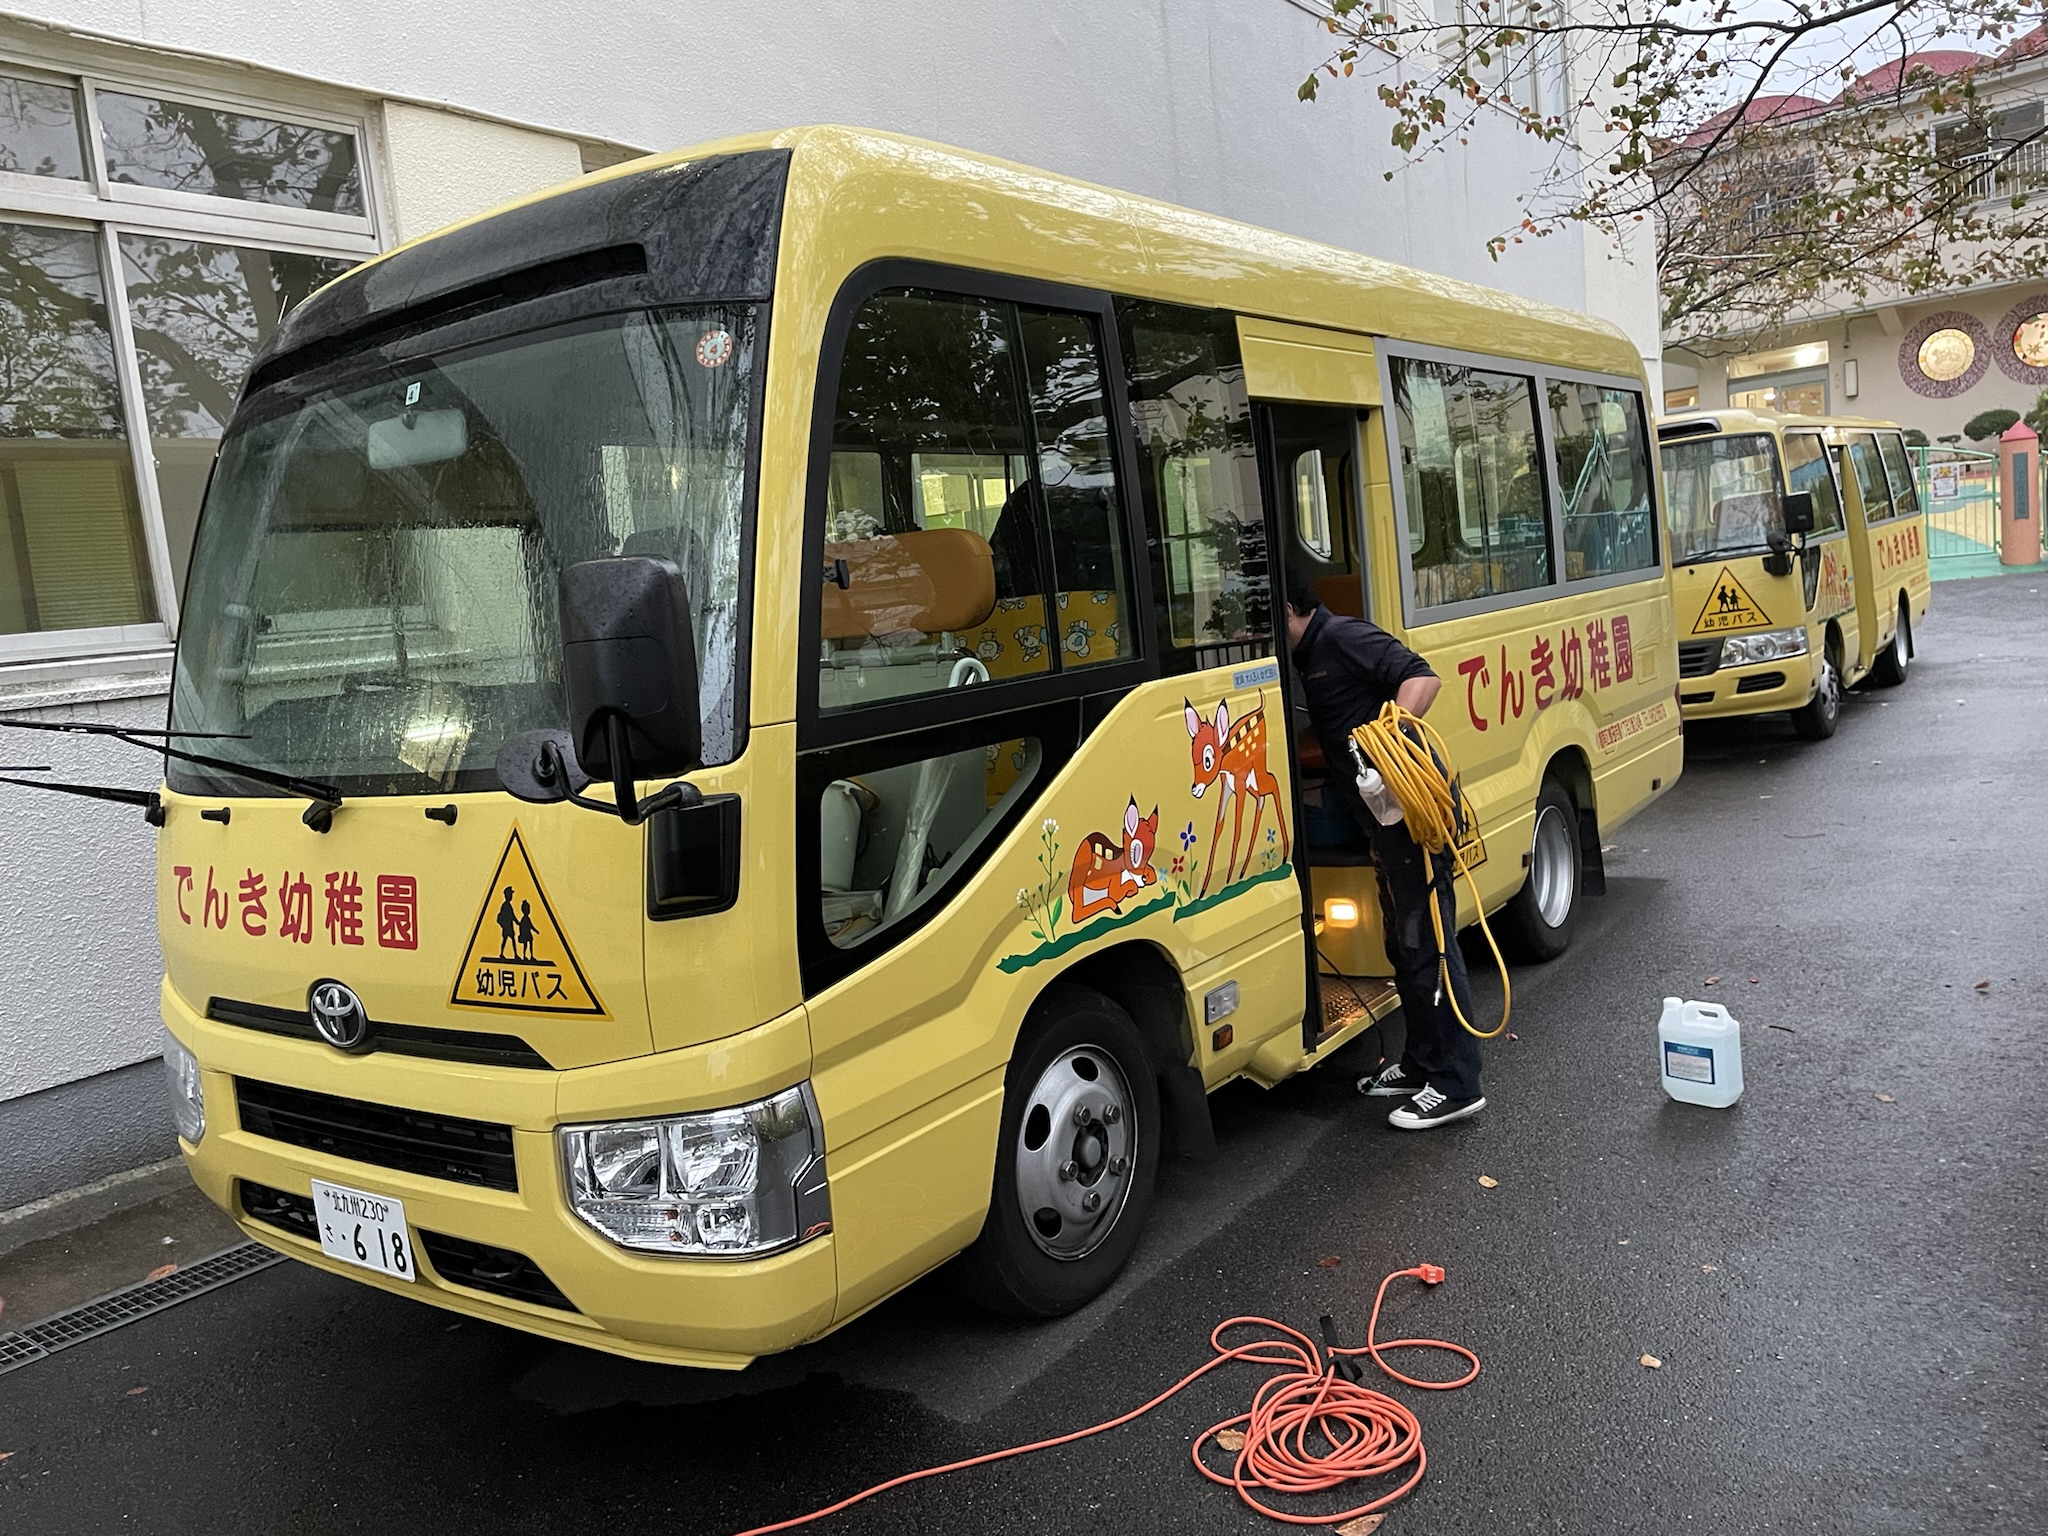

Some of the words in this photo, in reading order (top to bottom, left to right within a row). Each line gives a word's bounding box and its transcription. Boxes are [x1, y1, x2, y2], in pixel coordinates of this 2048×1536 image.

[1703, 611, 1757, 629] 幼児バス
[1458, 615, 1633, 731] でんき幼稚園
[173, 865, 419, 950] でんき幼稚園
[476, 967, 569, 1001] 幼児バス
